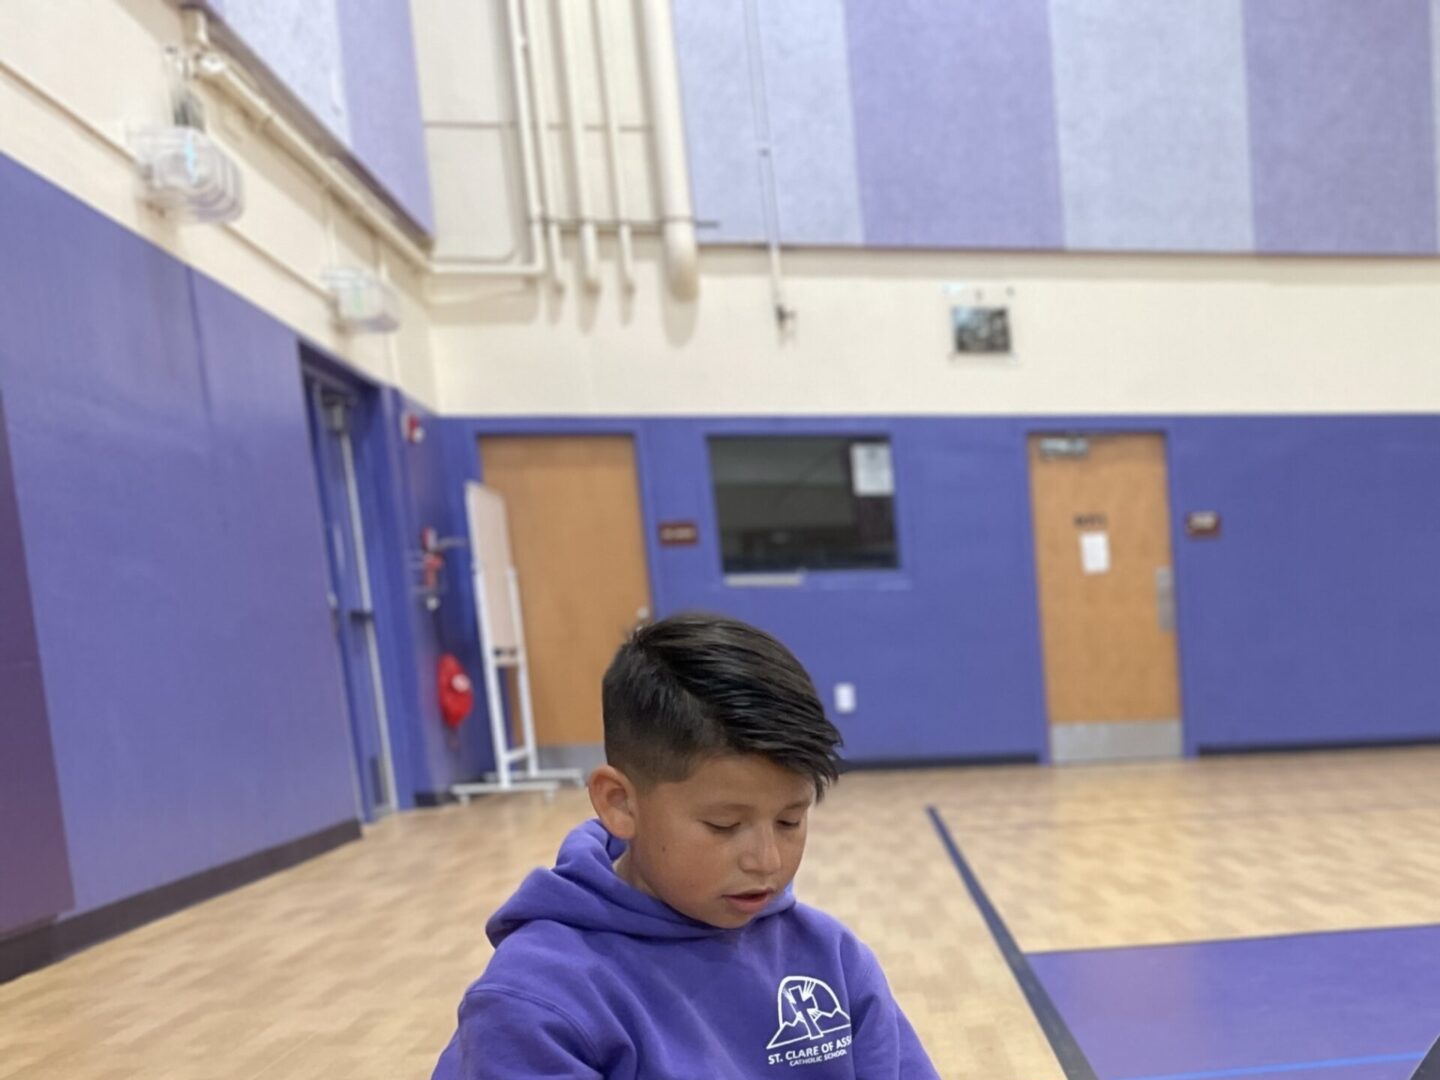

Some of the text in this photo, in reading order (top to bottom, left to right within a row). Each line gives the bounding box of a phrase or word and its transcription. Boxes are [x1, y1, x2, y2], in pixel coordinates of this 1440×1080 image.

[768, 1053, 784, 1065] ST.
[785, 1045, 820, 1061] CLARE
[820, 1041, 834, 1054] OF
[789, 1049, 848, 1067] CATHOLIC SCHOOL
